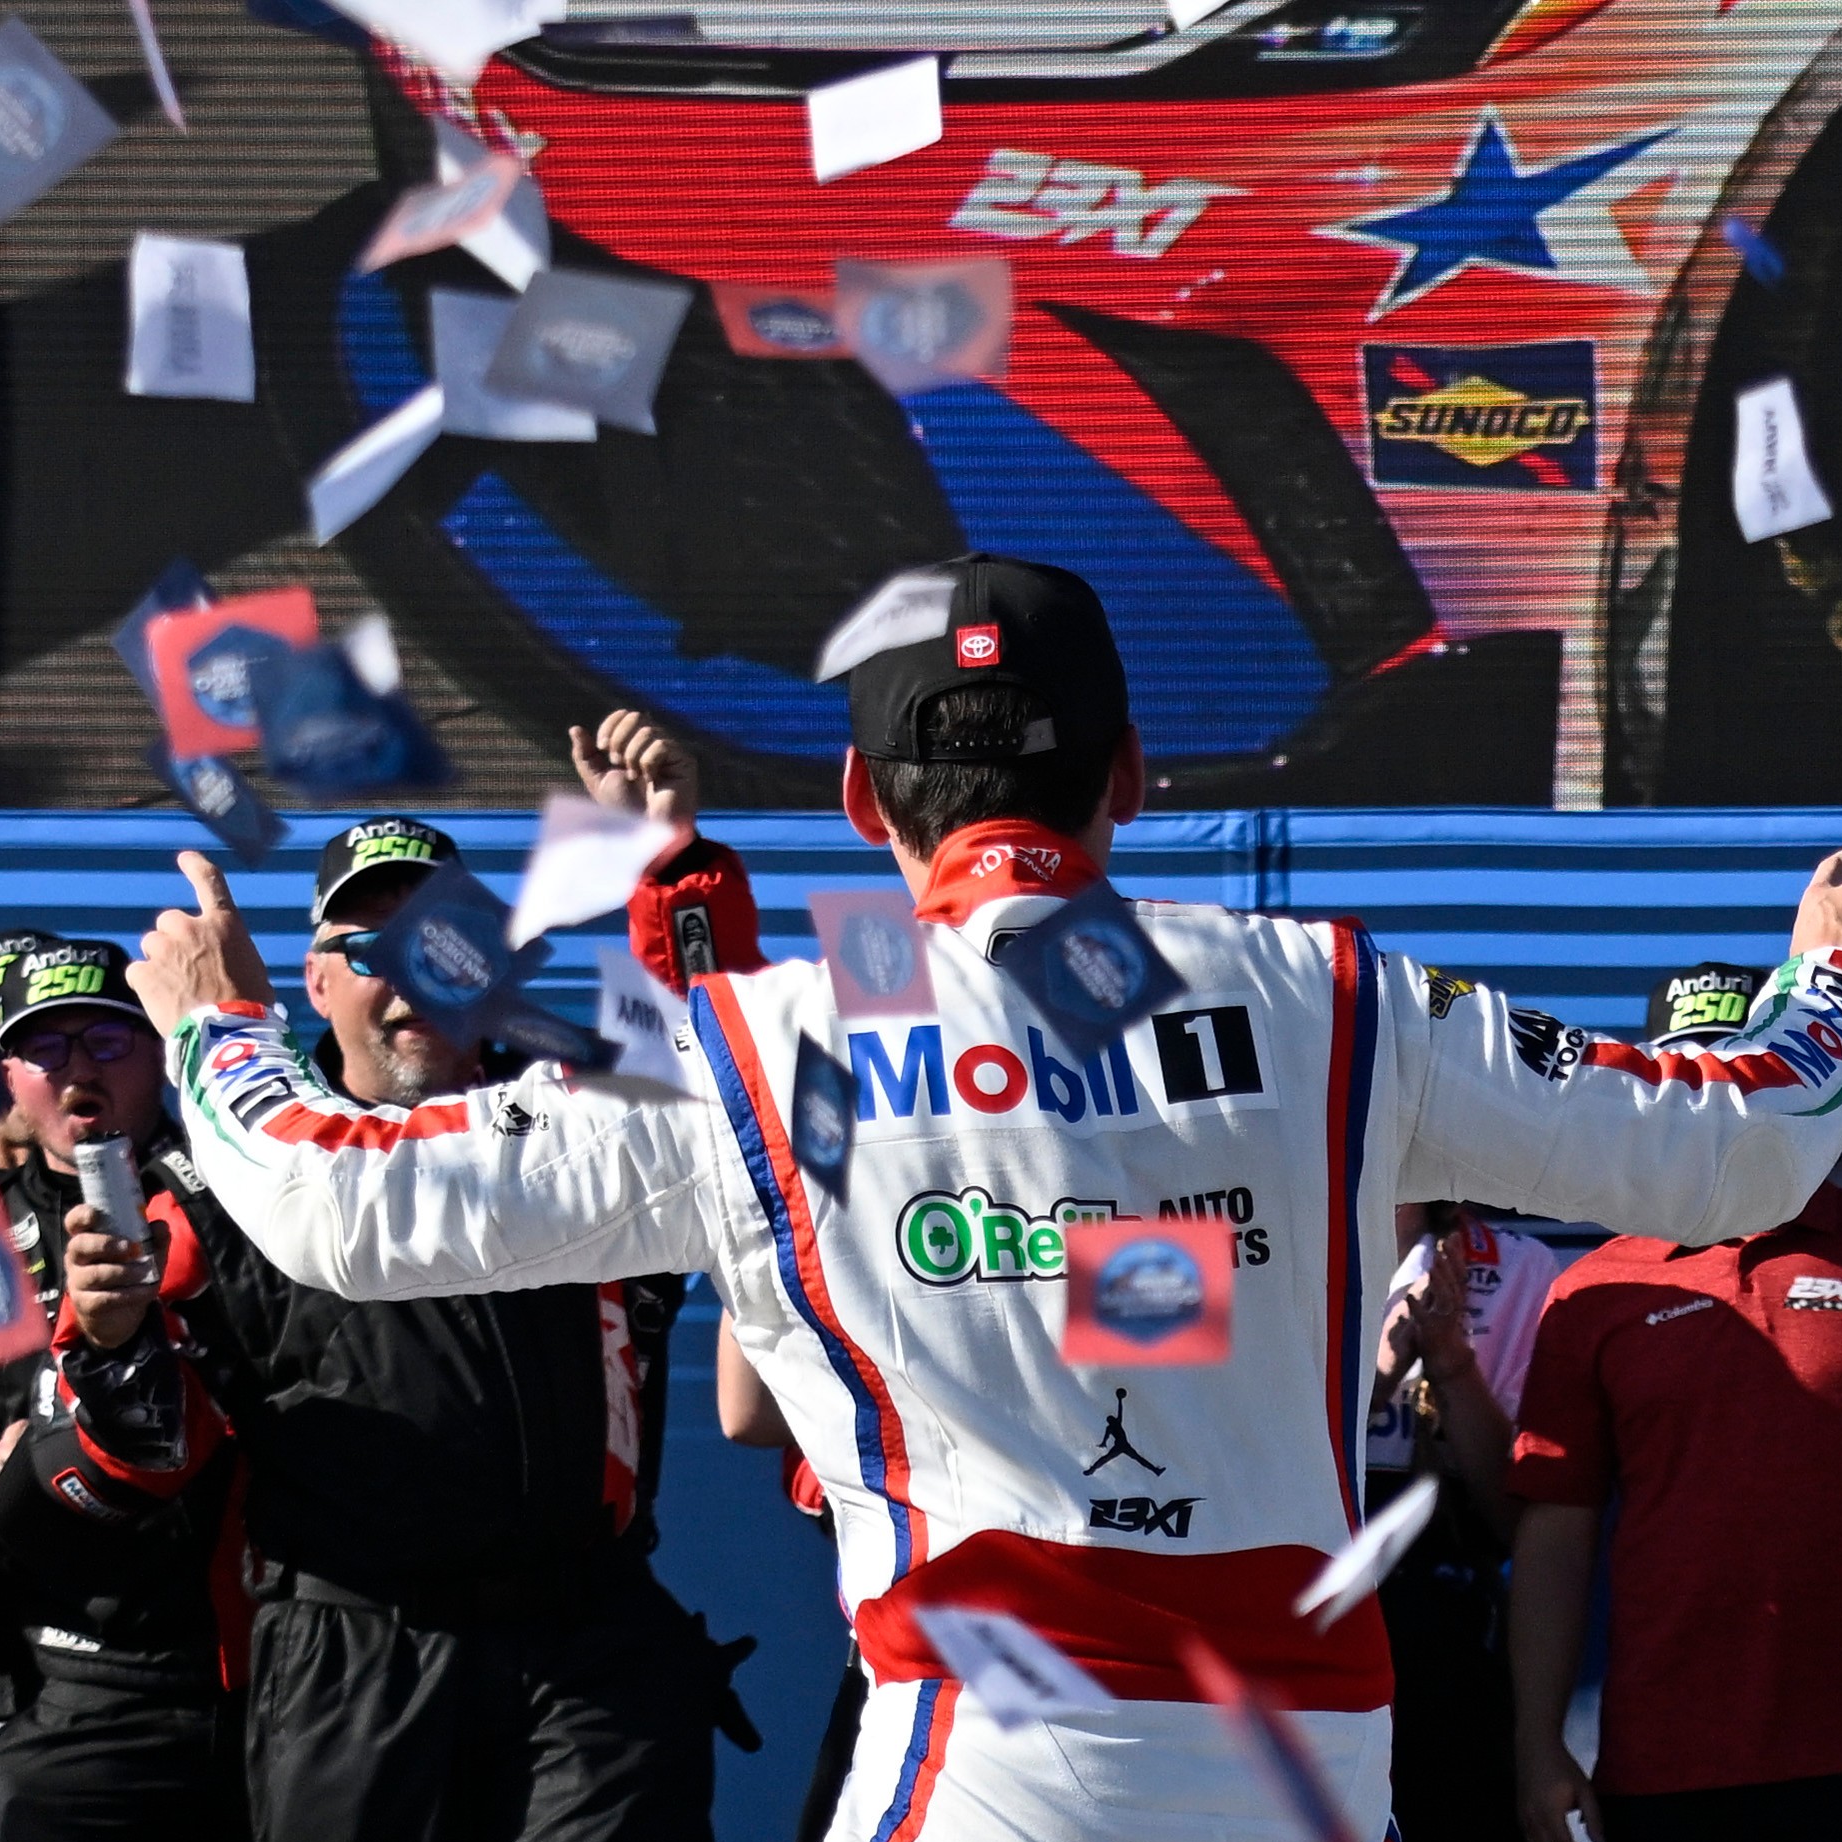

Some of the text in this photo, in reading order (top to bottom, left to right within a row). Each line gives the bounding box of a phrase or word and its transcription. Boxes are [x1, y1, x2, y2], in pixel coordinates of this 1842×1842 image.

[1385, 402, 1577, 437] SUNOCO
[26, 963, 106, 1006] 250
[1665, 972, 1753, 1003] Anduril
[1669, 991, 1749, 1032] 250
[848, 1025, 1140, 1124] Mobil
[1088, 1496, 1208, 1538] 23XI
